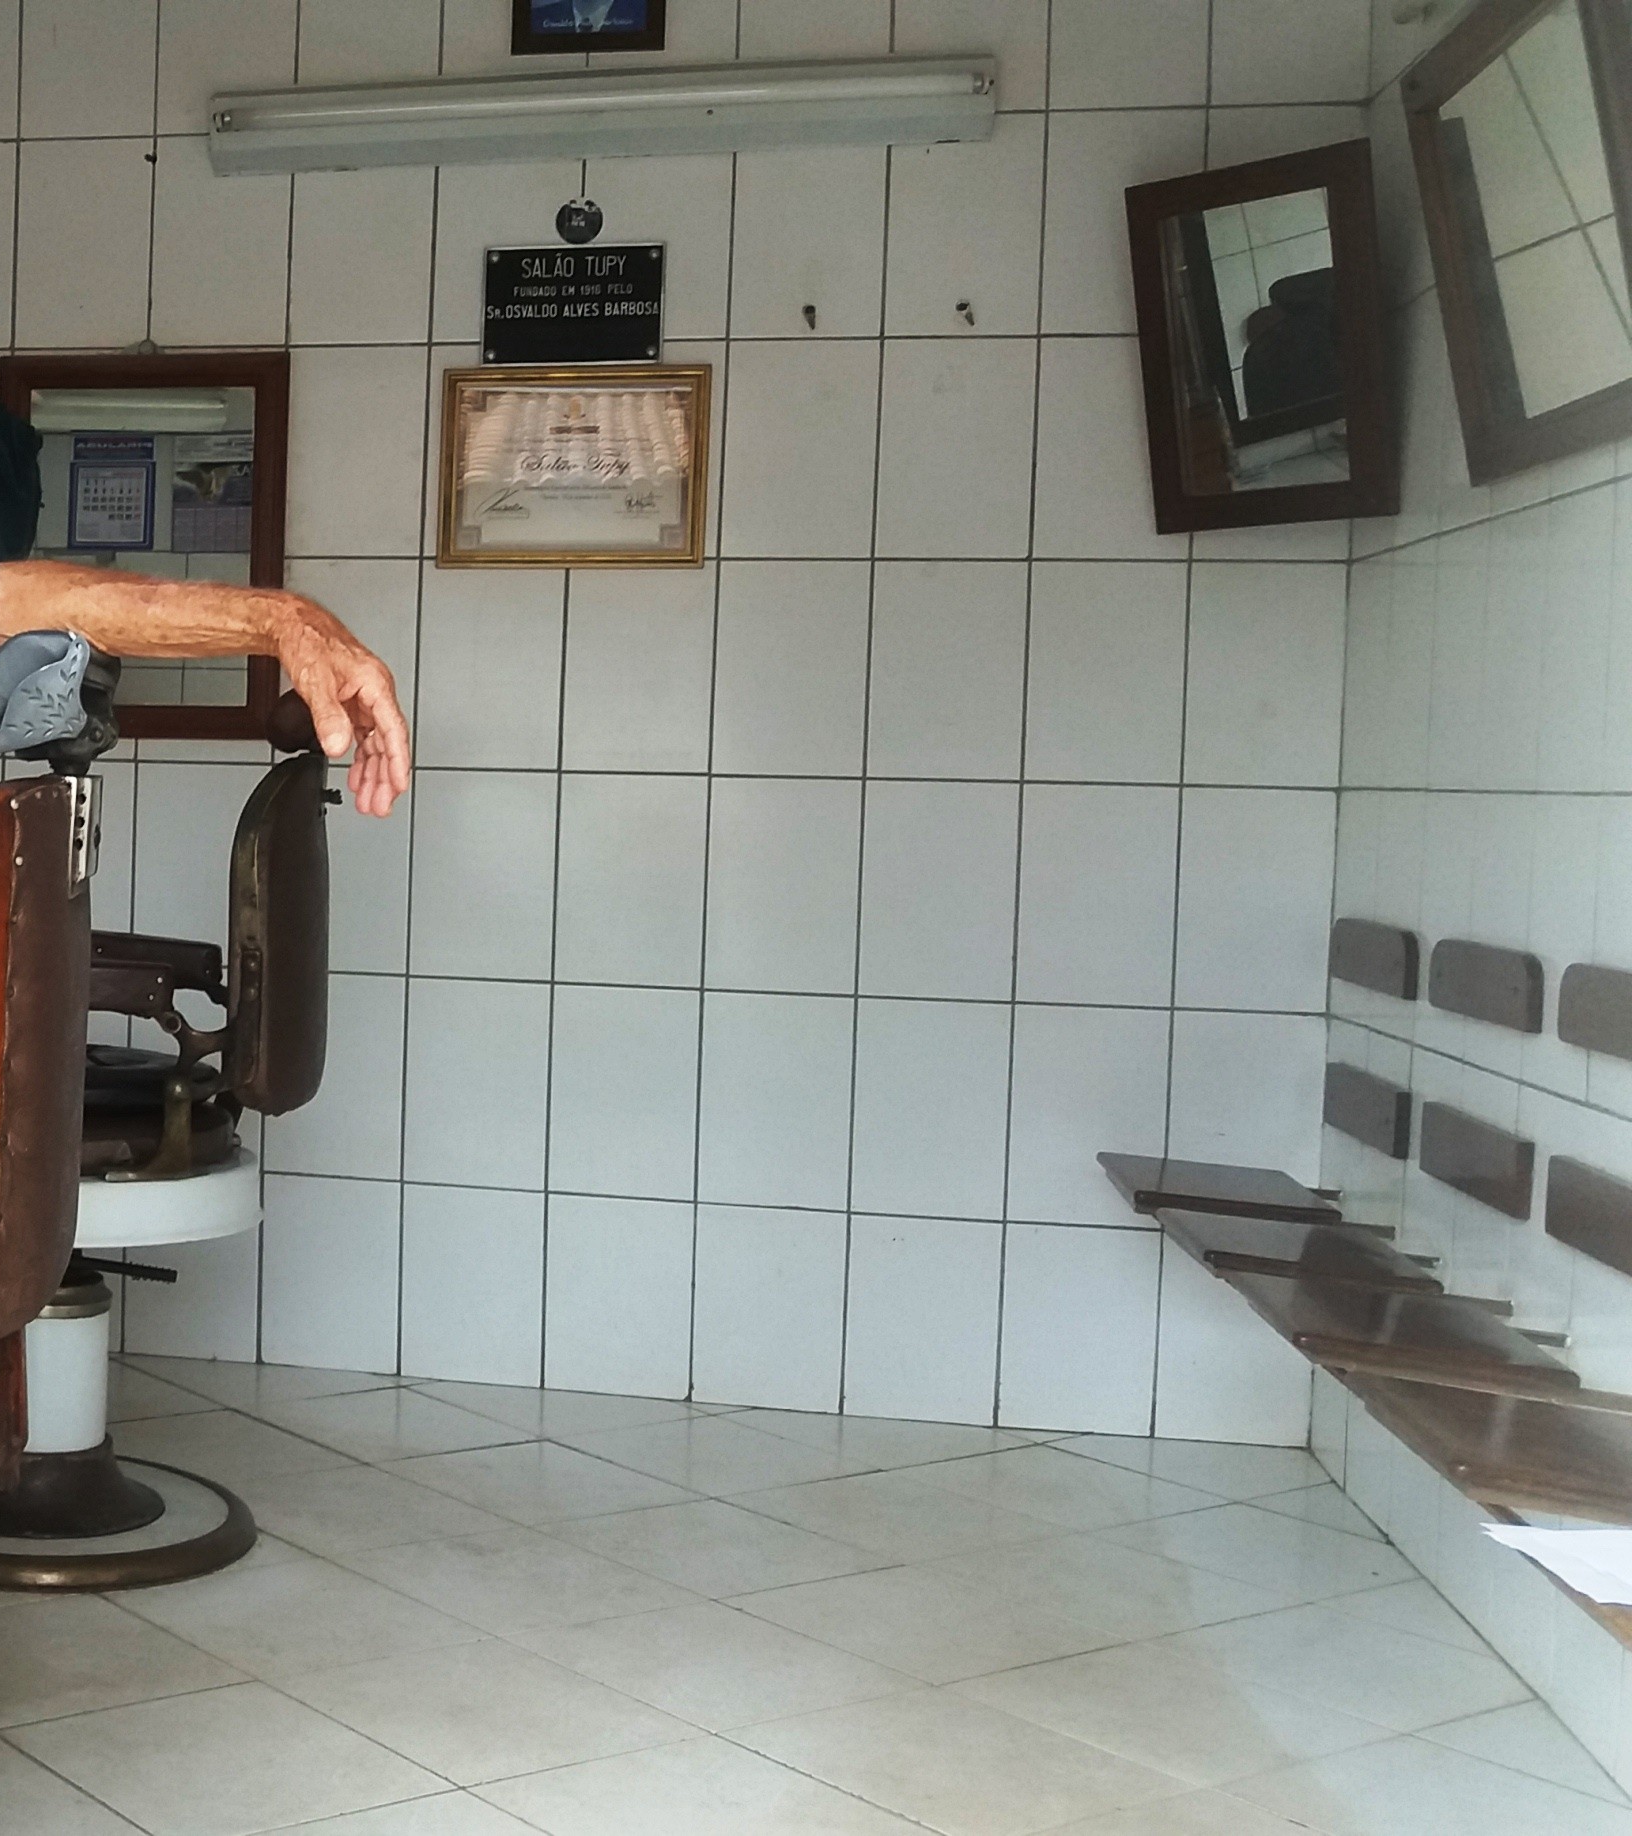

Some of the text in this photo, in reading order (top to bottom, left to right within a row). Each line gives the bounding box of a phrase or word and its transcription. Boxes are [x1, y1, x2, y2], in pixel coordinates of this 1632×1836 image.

[521, 252, 627, 279] SALÃO TUPY
[513, 286, 557, 298] FUNDADO
[561, 285, 575, 296] EM
[607, 283, 633, 295] PELO
[563, 302, 599, 318] ALVES
[604, 301, 659, 316] BARBOSA
